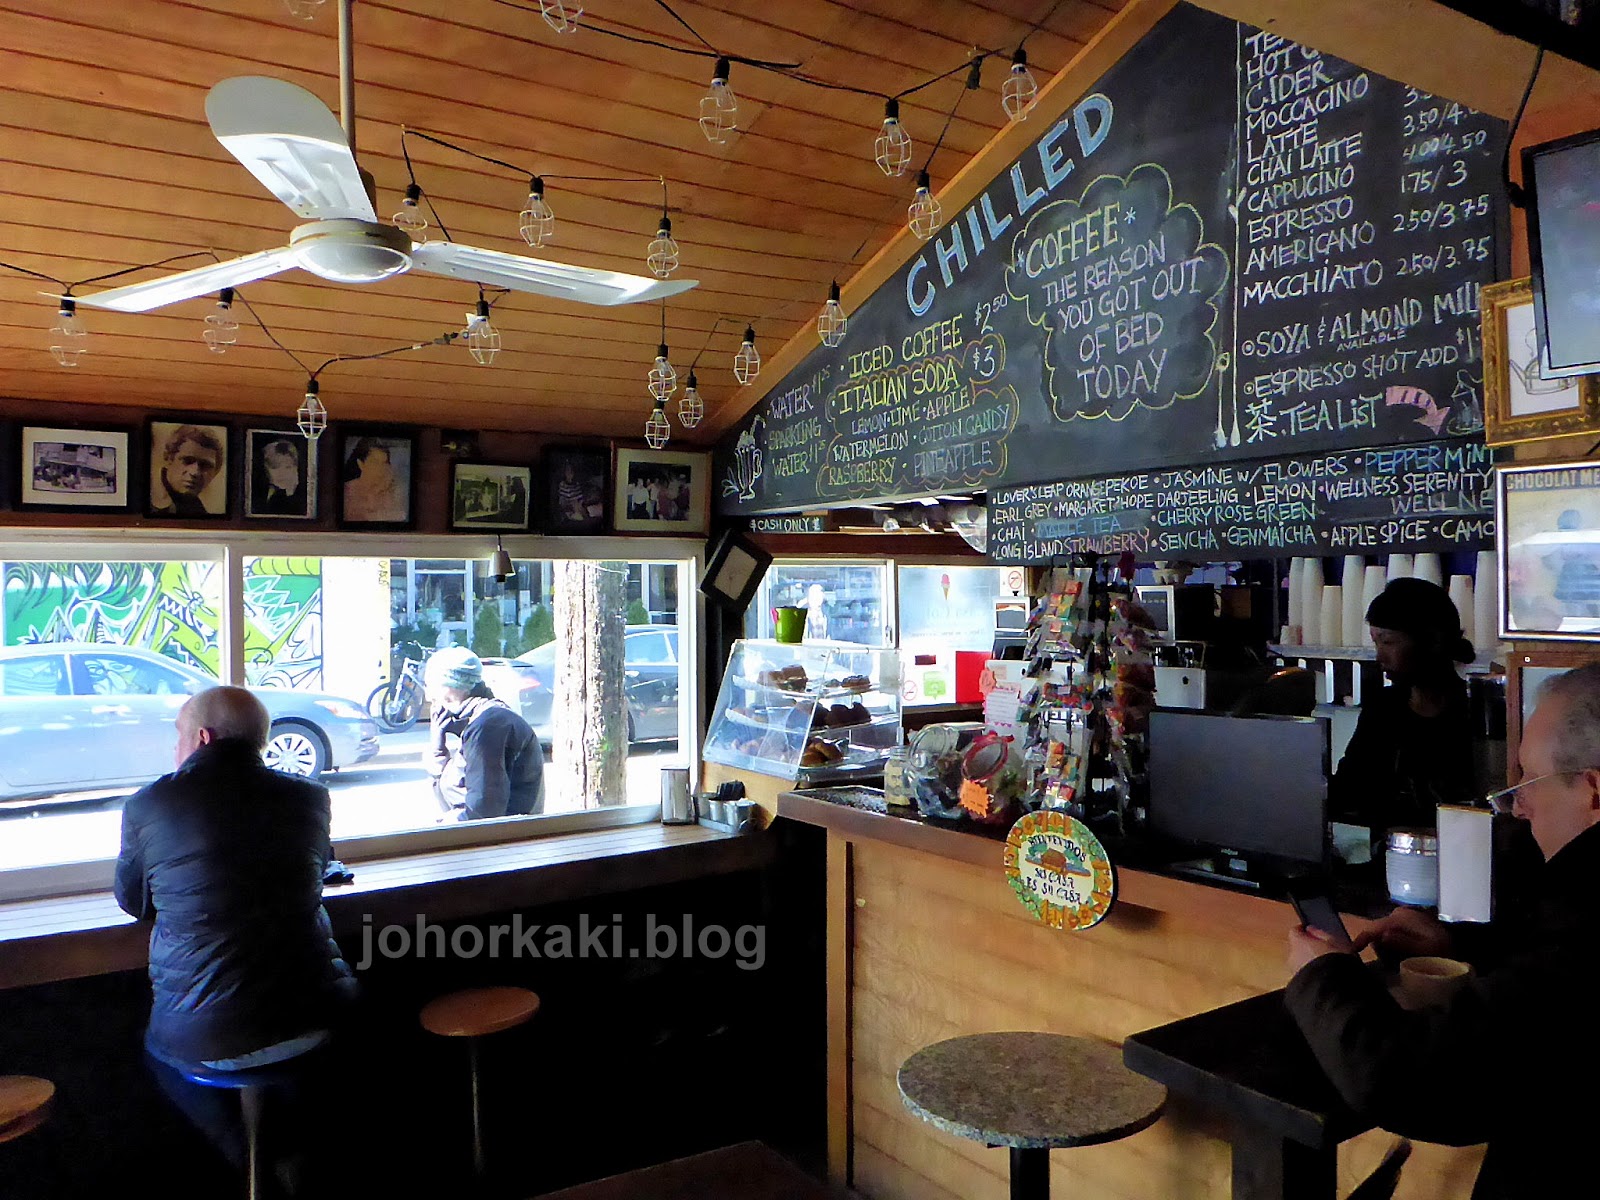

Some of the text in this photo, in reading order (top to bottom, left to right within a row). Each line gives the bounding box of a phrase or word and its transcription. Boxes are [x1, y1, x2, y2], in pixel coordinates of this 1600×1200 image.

[1246, 43, 1297, 84] HOT
[1246, 60, 1333, 113] CIDER
[1245, 73, 1369, 139] MOCCACINO
[1247, 119, 1318, 163] LATTE
[1299, 132, 1363, 170] LATTE
[907, 93, 1113, 317] CHILLED
[1248, 194, 1353, 243] ESPRESSO
[1042, 231, 1166, 306] THE REASON
[1058, 256, 1205, 334] YOU GOT OUT
[848, 345, 894, 378] ICED
[902, 313, 964, 362] COFFEE
[1079, 311, 1164, 363] OF BED
[1256, 323, 1311, 357] SOYA
[1329, 297, 1423, 342] ALMOND
[1336, 330, 1406, 352] AVAILABLE
[838, 345, 995, 415] ITALIAN SODA $3
[1077, 348, 1168, 402] TODAY
[1254, 360, 1356, 398] ESPRESSO
[1361, 347, 1416, 380] SHOT
[1415, 345, 1458, 369] ADD
[770, 383, 814, 420] WATER
[851, 411, 888, 435] LEMON
[925, 385, 971, 421] APPLE
[833, 430, 909, 462] WATERMELON
[965, 403, 1010, 436] CANDY
[772, 451, 811, 477] WATER
[828, 457, 896, 486] RASPBERRY
[1106, 475, 1148, 496] PEKOE
[1264, 456, 1348, 482] FLOWERS
[1507, 470, 1577, 489] CHOCOLAT
[758, 518, 781, 530] CASH
[784, 517, 809, 532] ONLY
[995, 507, 1023, 524] EARL
[1025, 502, 1052, 519] GREY
[1121, 493, 1154, 509] HOPE
[1254, 480, 1316, 505] LEMON
[1091, 515, 1121, 534] TEA
[1158, 506, 1212, 526] CHERRY
[1215, 505, 1253, 524] ROSE
[1256, 502, 1315, 524] GREEN
[995, 543, 1021, 560] LONG
[1159, 528, 1219, 551] SENCHA
[1330, 524, 1376, 547] APPLE
